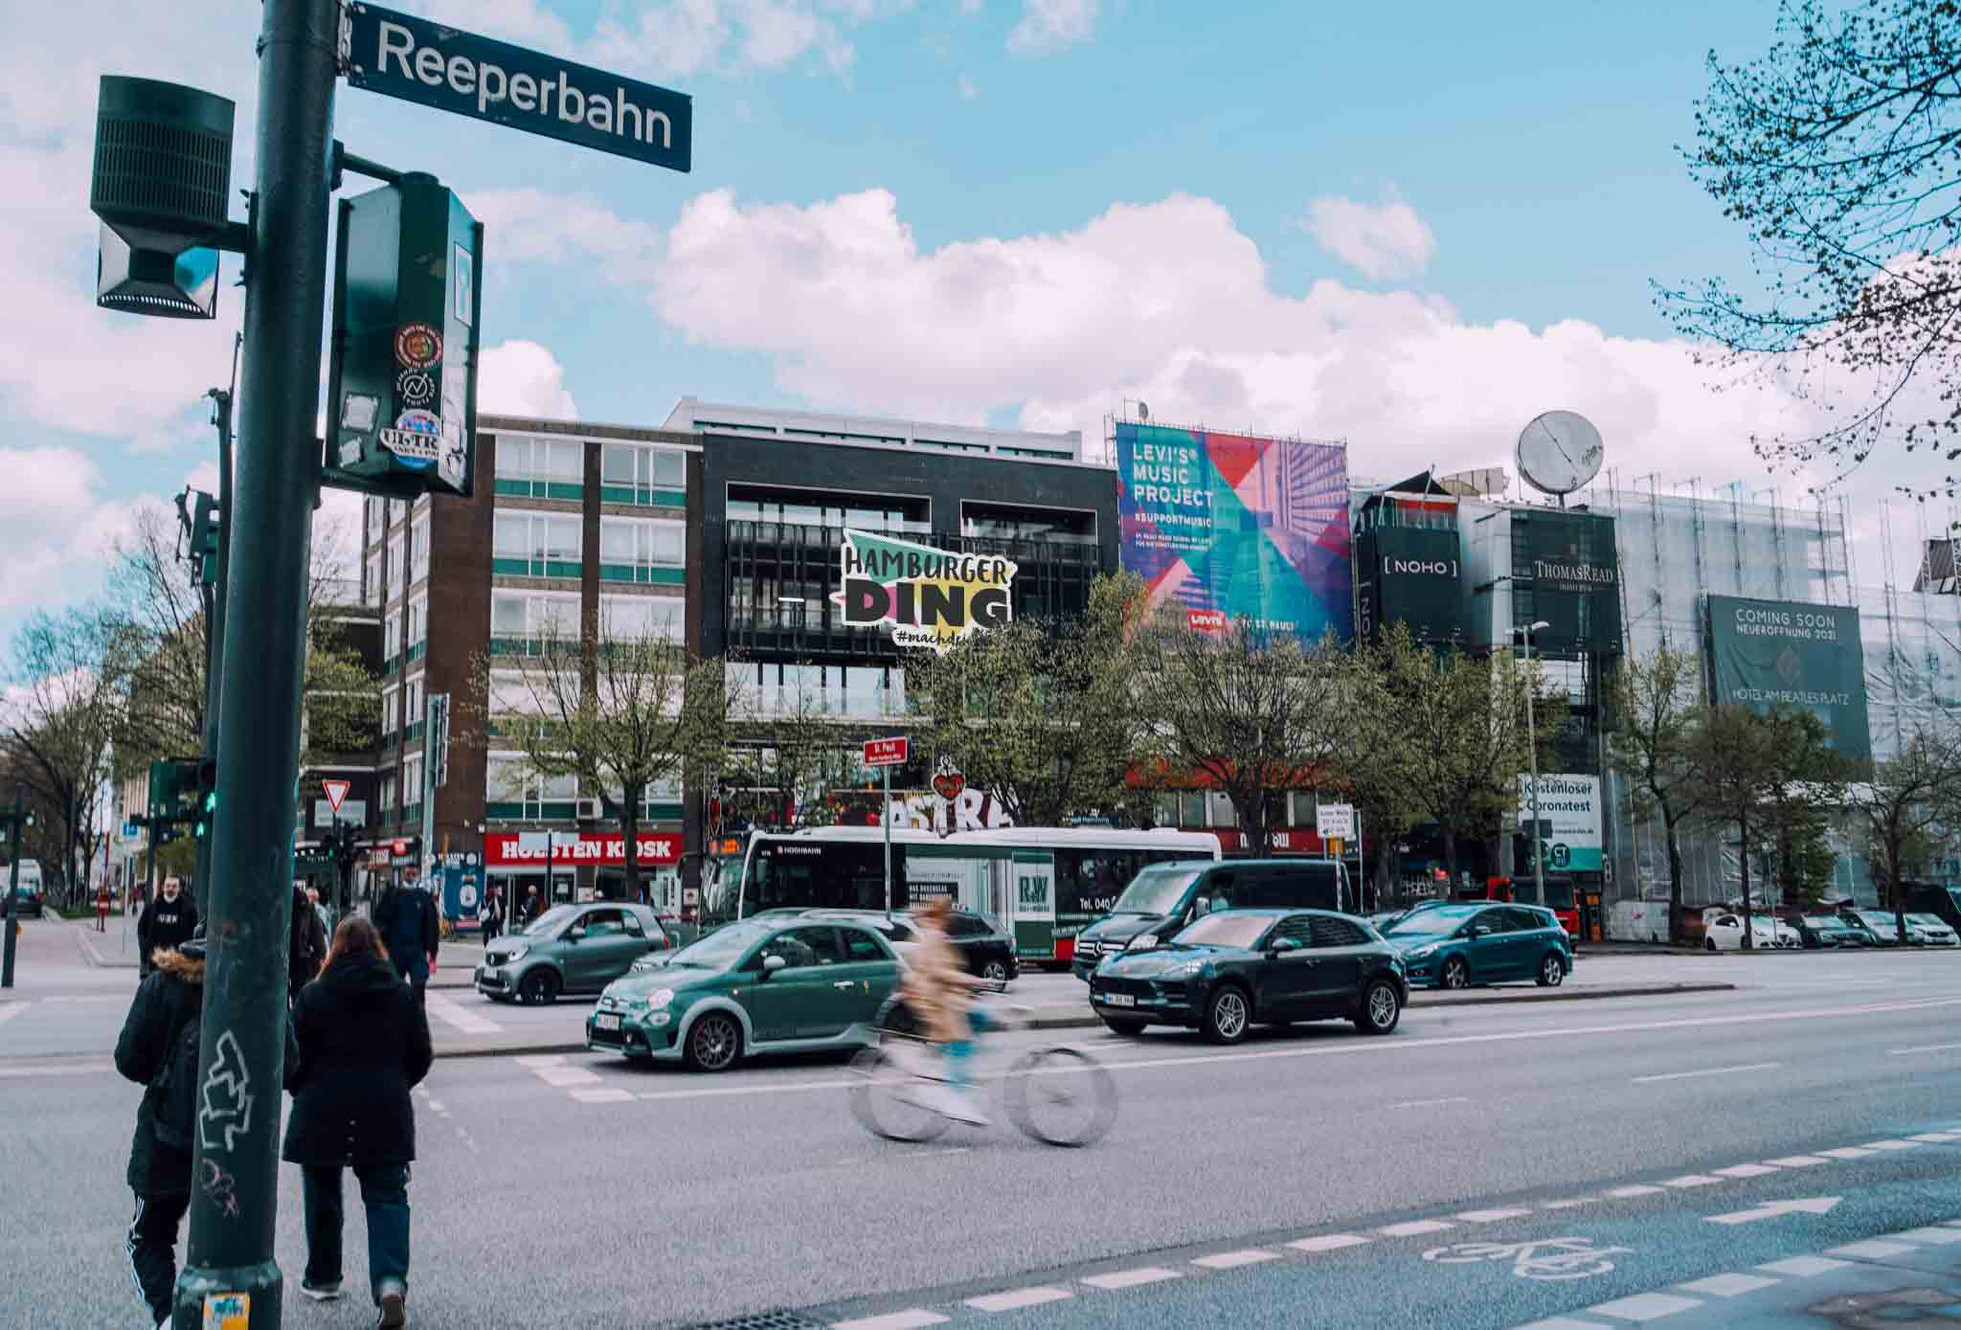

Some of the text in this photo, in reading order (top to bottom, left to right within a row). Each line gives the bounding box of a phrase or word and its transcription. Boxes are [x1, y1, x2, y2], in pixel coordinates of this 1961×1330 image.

[376, 20, 671, 149] Reeperbahn
[1133, 462, 1189, 484] MUSIC
[1134, 484, 1213, 506] PROJECT
[1135, 512, 1211, 527] #SUPPORTMUSIC
[845, 547, 1009, 584] HAMBURGER
[845, 578, 1009, 628] DING
[1736, 609, 1835, 629] COMING SOON
[1815, 630, 1837, 640] 2021
[1733, 688, 1763, 701] HOTEL
[1080, 898, 1093, 910] Tel.
